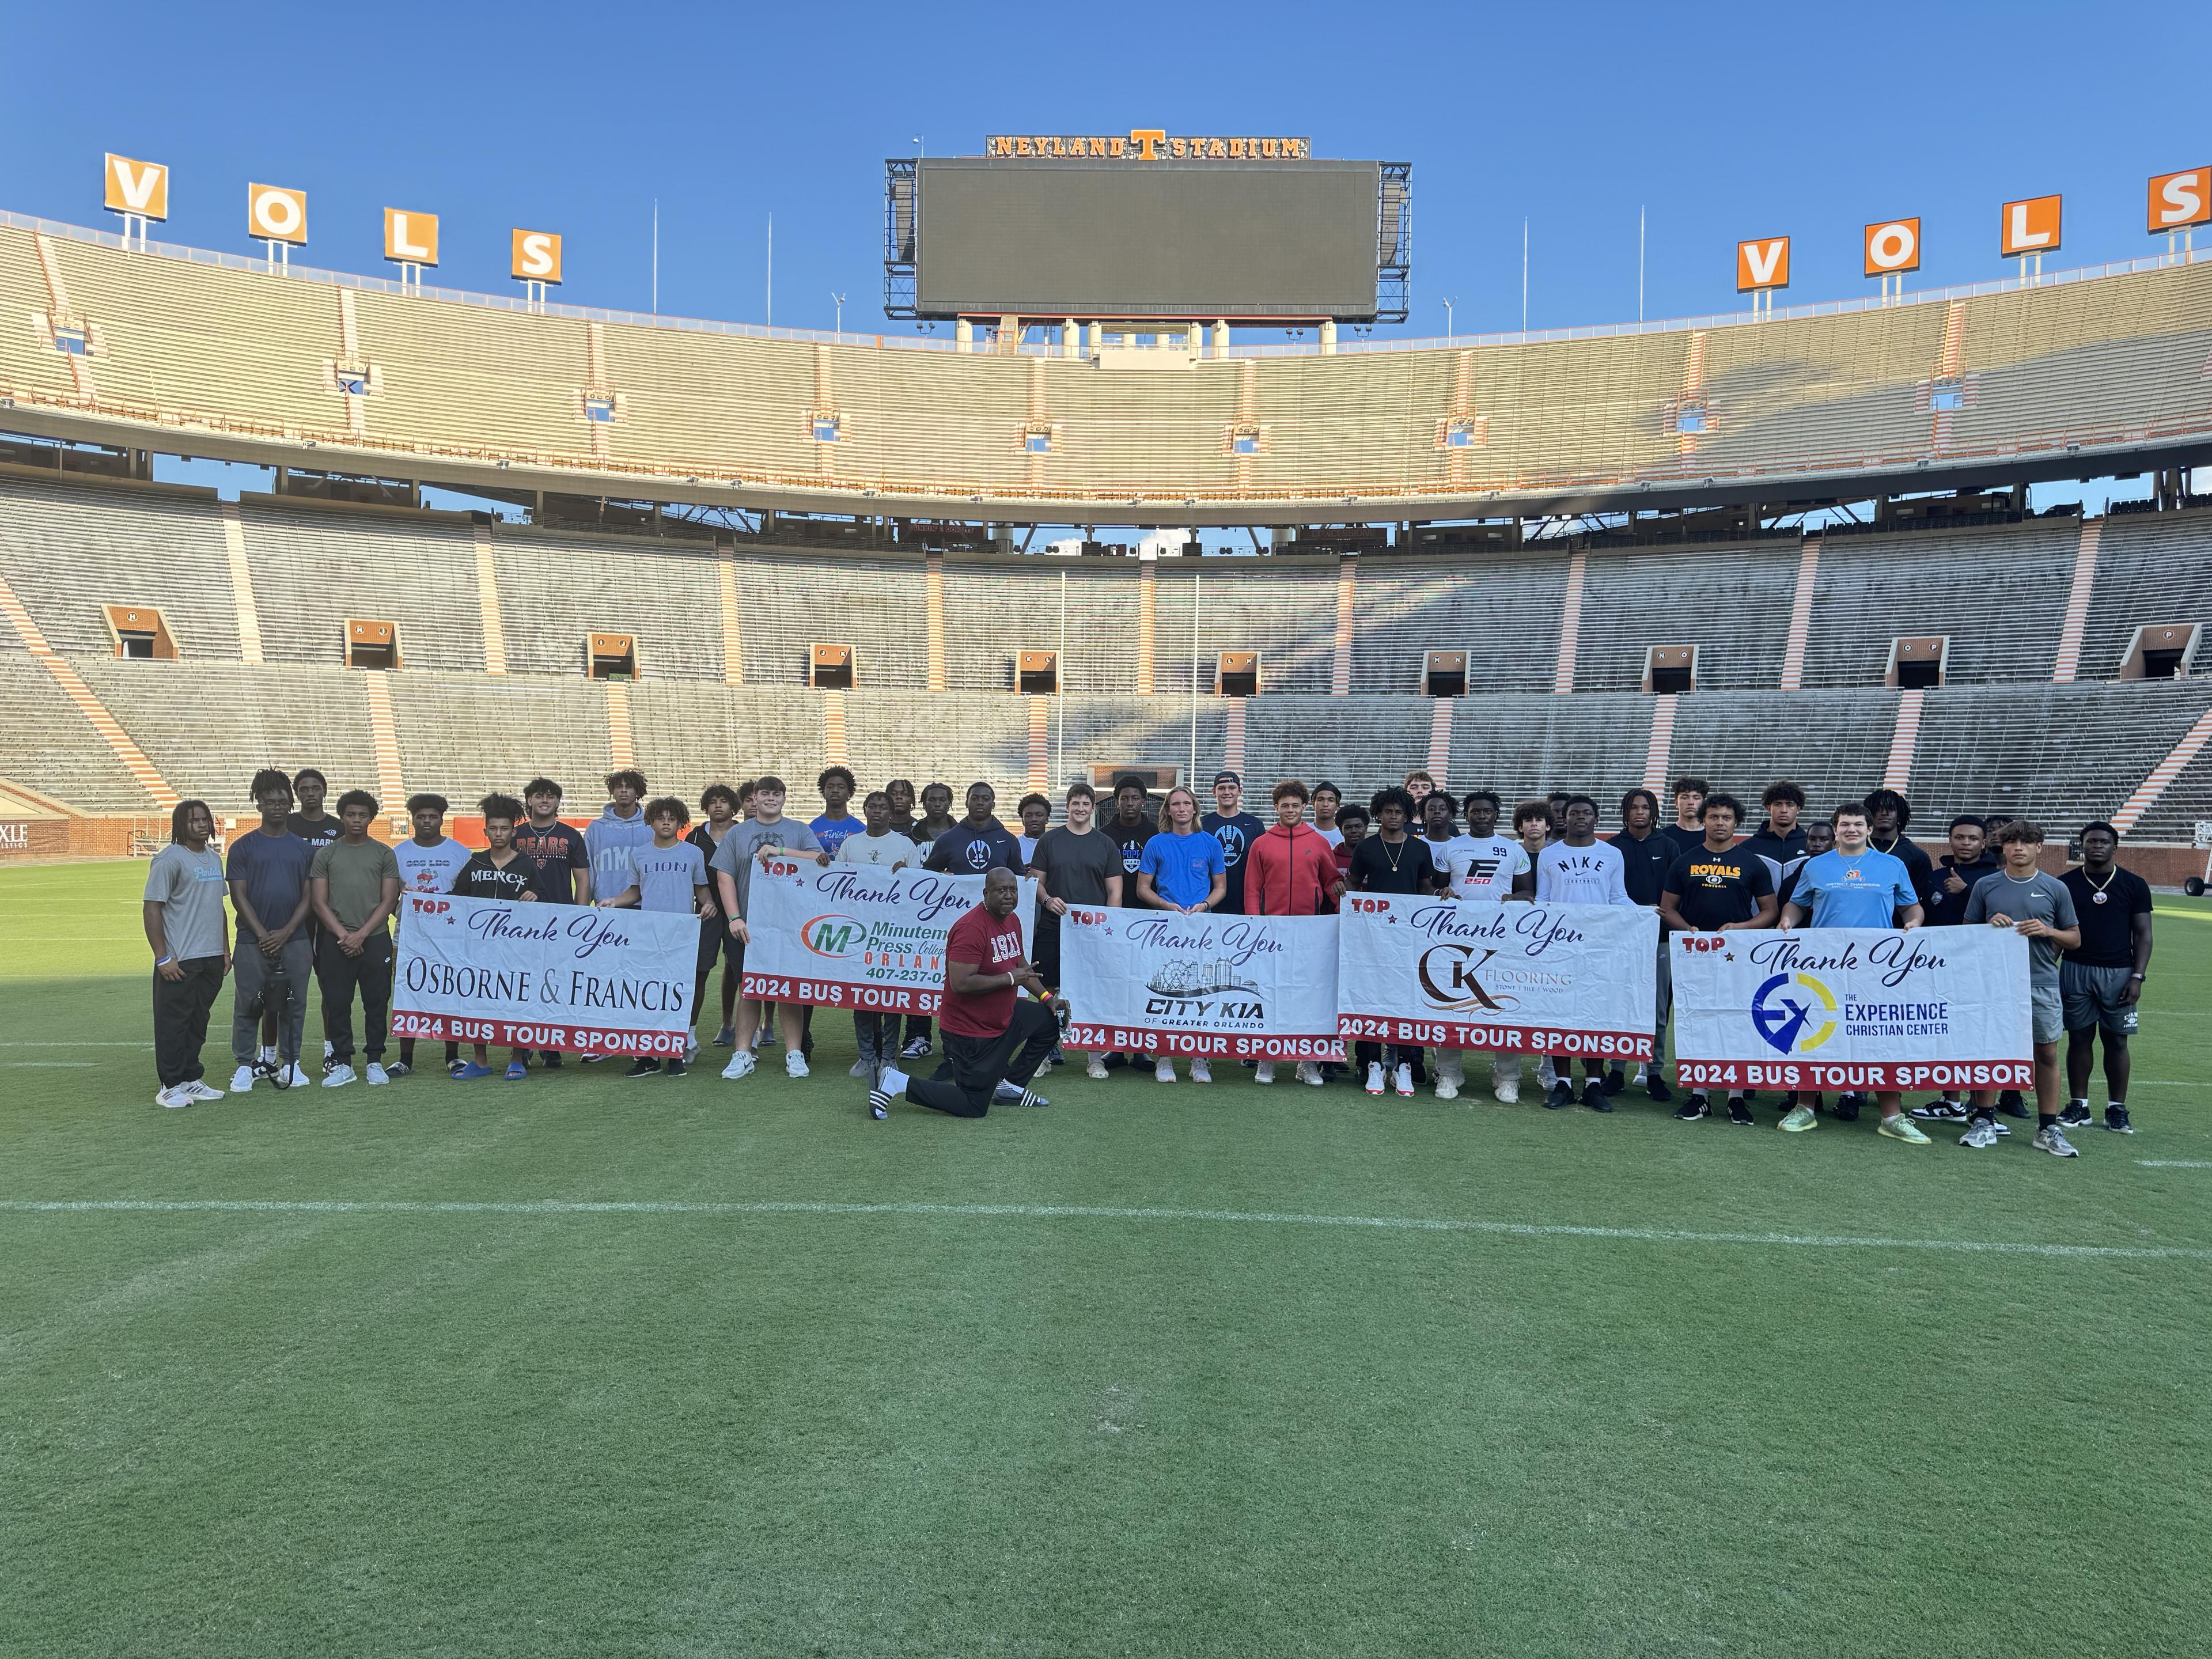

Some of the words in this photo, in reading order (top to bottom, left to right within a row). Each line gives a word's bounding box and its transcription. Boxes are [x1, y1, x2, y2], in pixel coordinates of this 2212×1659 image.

[995, 136, 1124, 156] NEYLAND
[1131, 130, 1166, 161] T
[1172, 138, 1301, 157] STADIUM
[112, 160, 161, 210] V
[2161, 173, 2200, 224] S
[254, 190, 302, 236] O
[392, 213, 430, 259] L
[2012, 204, 2051, 249] L
[521, 234, 554, 276] S
[1870, 224, 1915, 268] O
[1743, 240, 1784, 284] V
[0, 824, 28, 842] XLE
[311, 838, 334, 847] MAR
[516, 836, 569, 856] BEARS
[1493, 846, 1508, 857] 99
[645, 861, 687, 874] LION
[763, 861, 798, 876] TOP
[1557, 856, 1604, 873] NIKE
[1690, 864, 1741, 877] ROYALS
[471, 869, 528, 892] MERCY
[412, 898, 450, 914] TOP
[816, 870, 900, 904] Thank
[909, 877, 972, 922] You
[1351, 897, 1391, 913] TOP
[1071, 910, 1108, 925] TOP
[468, 908, 558, 941] Thank
[567, 914, 631, 959] You
[1410, 905, 1506, 939] Thank
[1515, 909, 1585, 957] You
[866, 937, 913, 955] Press
[990, 931, 1021, 964] 1911
[1126, 918, 1213, 950] Thank
[1221, 922, 1284, 967] You
[1682, 937, 1726, 952] TOP
[863, 951, 939, 970] ORLAN
[1749, 937, 1858, 975] Thank
[1869, 936, 1947, 987] You
[406, 956, 531, 1002] OSBORNE
[540, 968, 562, 1005] &
[568, 969, 685, 1013] FRANCIS
[1485, 969, 1573, 986] FLOORING
[743, 977, 791, 997] 2024
[799, 982, 843, 1002] BUS
[851, 987, 911, 1009] TOUR
[1844, 994, 1858, 1002] THE
[1145, 998, 1215, 1017] CITY
[1219, 1001, 1265, 1019] KIA
[1845, 1002, 1949, 1021] EXPERIENCE
[392, 1014, 444, 1035] 2024
[450, 1020, 494, 1040] BUS
[503, 1025, 566, 1047] TOUR
[574, 1029, 685, 1054] SPONSOR
[1161, 1018, 1209, 1027] GREATER
[1213, 1021, 1264, 1029] ORLANDO
[1846, 1024, 1904, 1036] CHRISTIAN
[1907, 1023, 1949, 1036] CENTER
[1114, 1031, 1158, 1050] BUS
[1166, 1034, 1228, 1054] TOUR
[1236, 1038, 1347, 1056] SPONSOR
[1339, 1018, 1389, 1037] 2024
[1399, 1022, 1446, 1043] BUS
[1455, 1027, 1523, 1048] TOUR
[1531, 1031, 1653, 1058] SPONSOR
[1679, 1064, 1738, 1084] 2024
[1747, 1064, 1801, 1085] BUS
[1810, 1065, 1885, 1086] TOUR
[1895, 1064, 2033, 1086] SPONSOR
